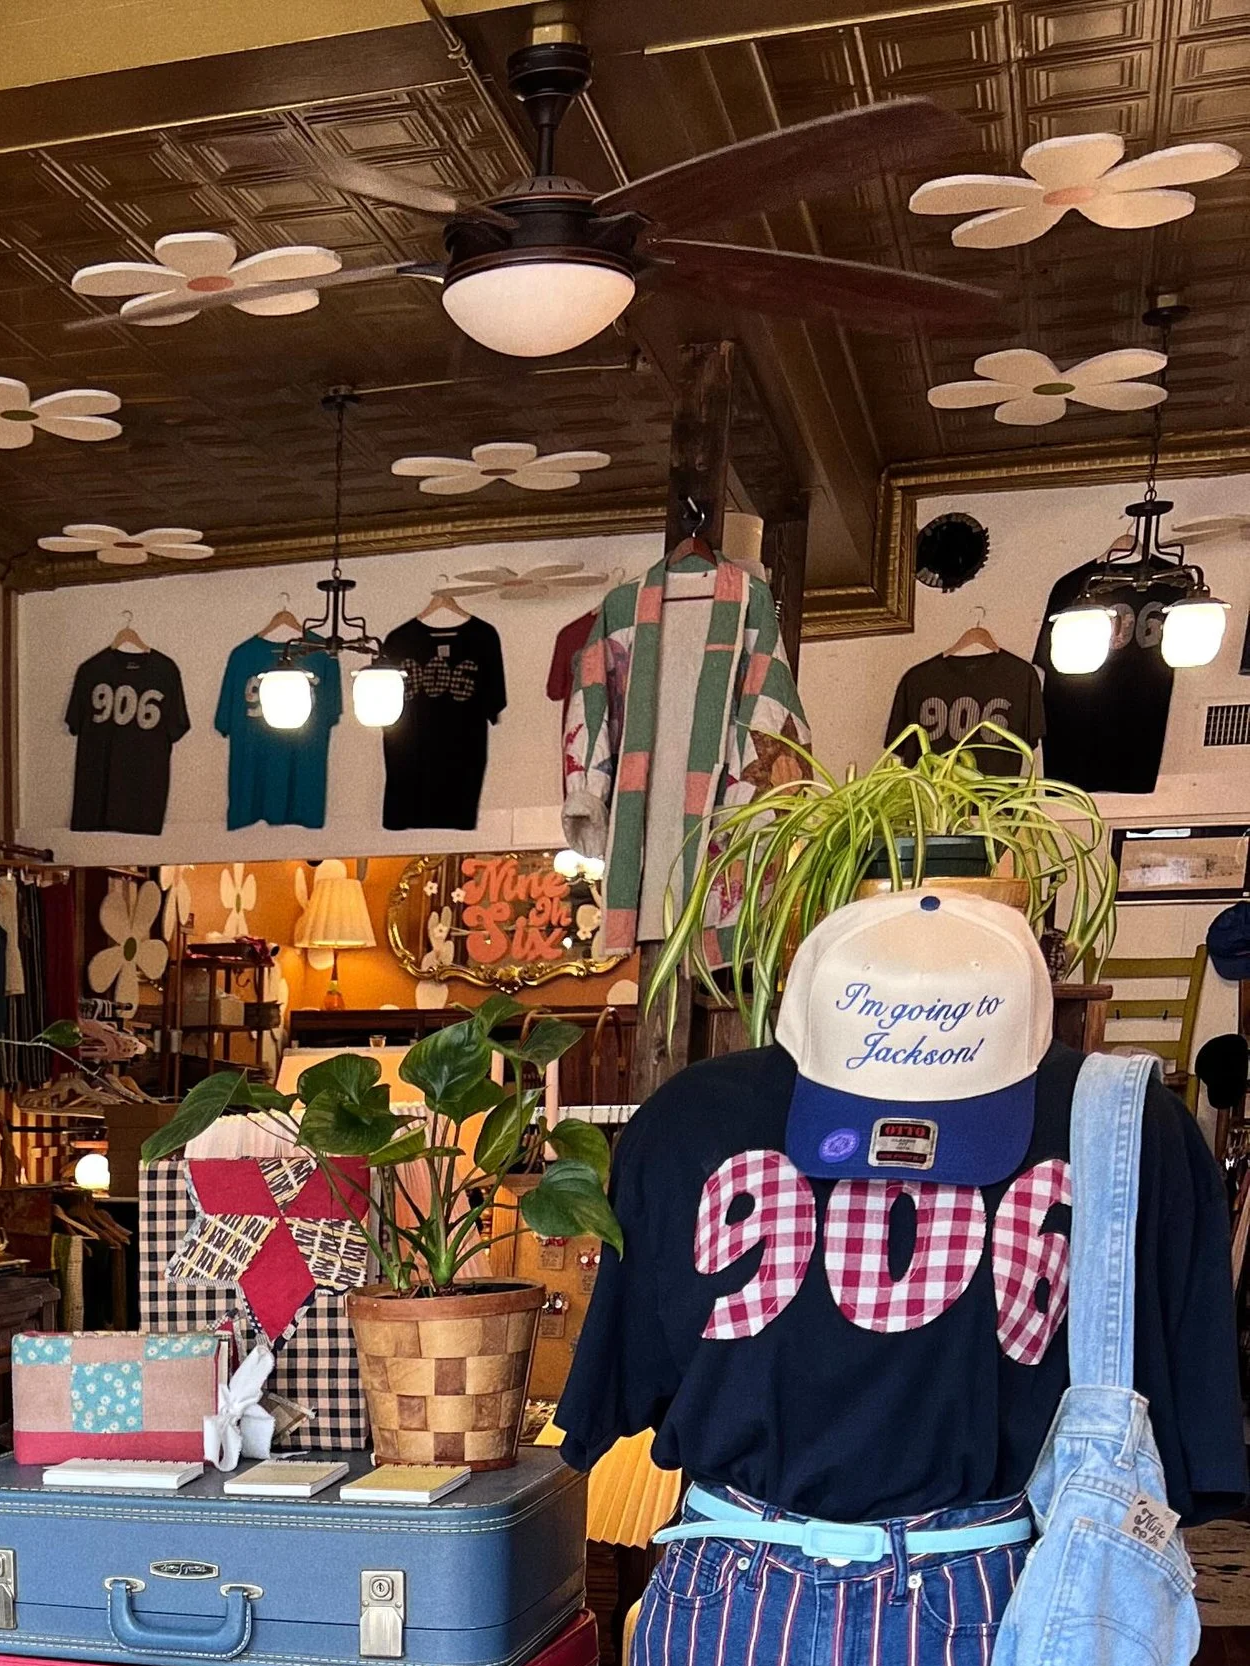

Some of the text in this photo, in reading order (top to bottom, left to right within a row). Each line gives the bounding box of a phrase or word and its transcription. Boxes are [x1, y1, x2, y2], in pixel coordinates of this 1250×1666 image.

[92, 682, 165, 730] 906
[918, 696, 1012, 744] 906
[461, 857, 571, 905] Nine
[462, 901, 568, 964] Six
[529, 896, 573, 927] Oh
[835, 983, 1006, 1032] I'm going to
[845, 1031, 986, 1070] Jackson!
[884, 1125, 926, 1137] OTTO
[694, 1149, 1072, 1366] 906
[1134, 1507, 1166, 1539] Nine
